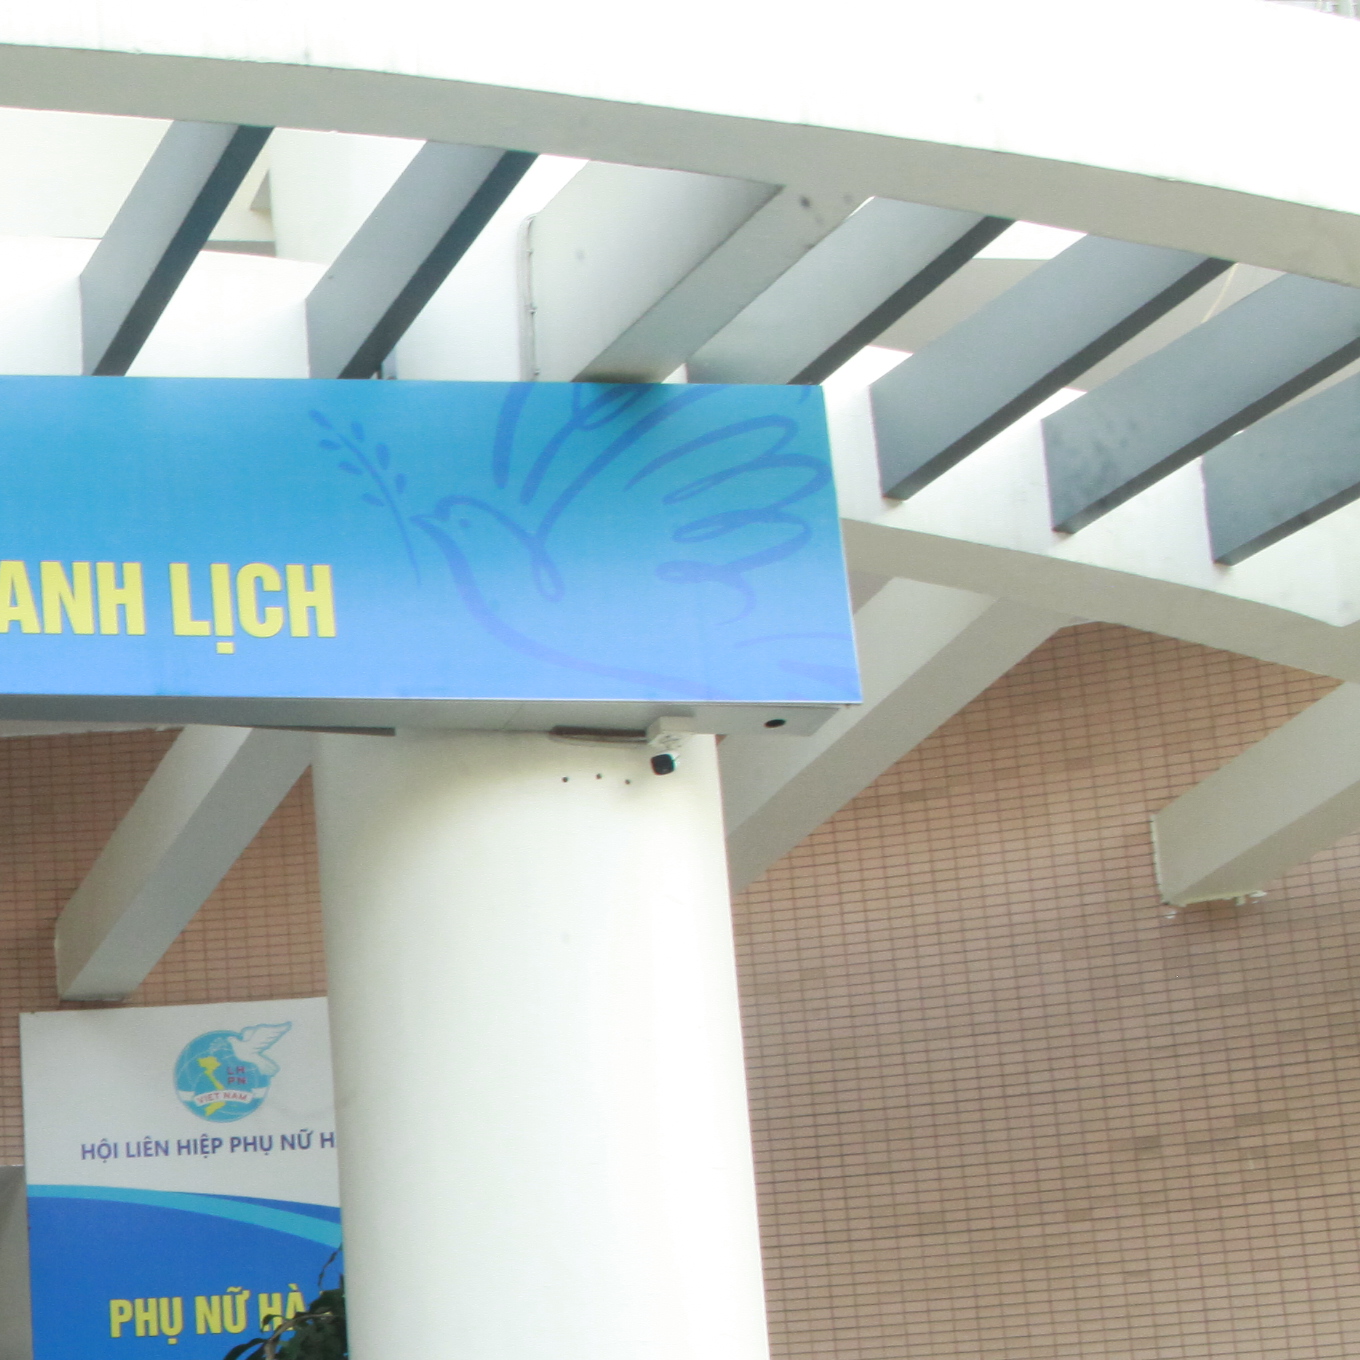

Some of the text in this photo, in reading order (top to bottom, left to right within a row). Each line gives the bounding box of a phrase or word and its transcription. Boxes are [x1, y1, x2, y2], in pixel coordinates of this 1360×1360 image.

[168, 561, 337, 656] LỊCH
[80, 1138, 119, 1163] HỘI
[125, 1135, 170, 1159] LIÊN
[176, 1133, 224, 1158] HIỆP
[229, 1134, 274, 1156] PHỤ
[280, 1128, 315, 1151] NỮ
[109, 1296, 184, 1345] PHỤ
[195, 1286, 251, 1335] NỮ
